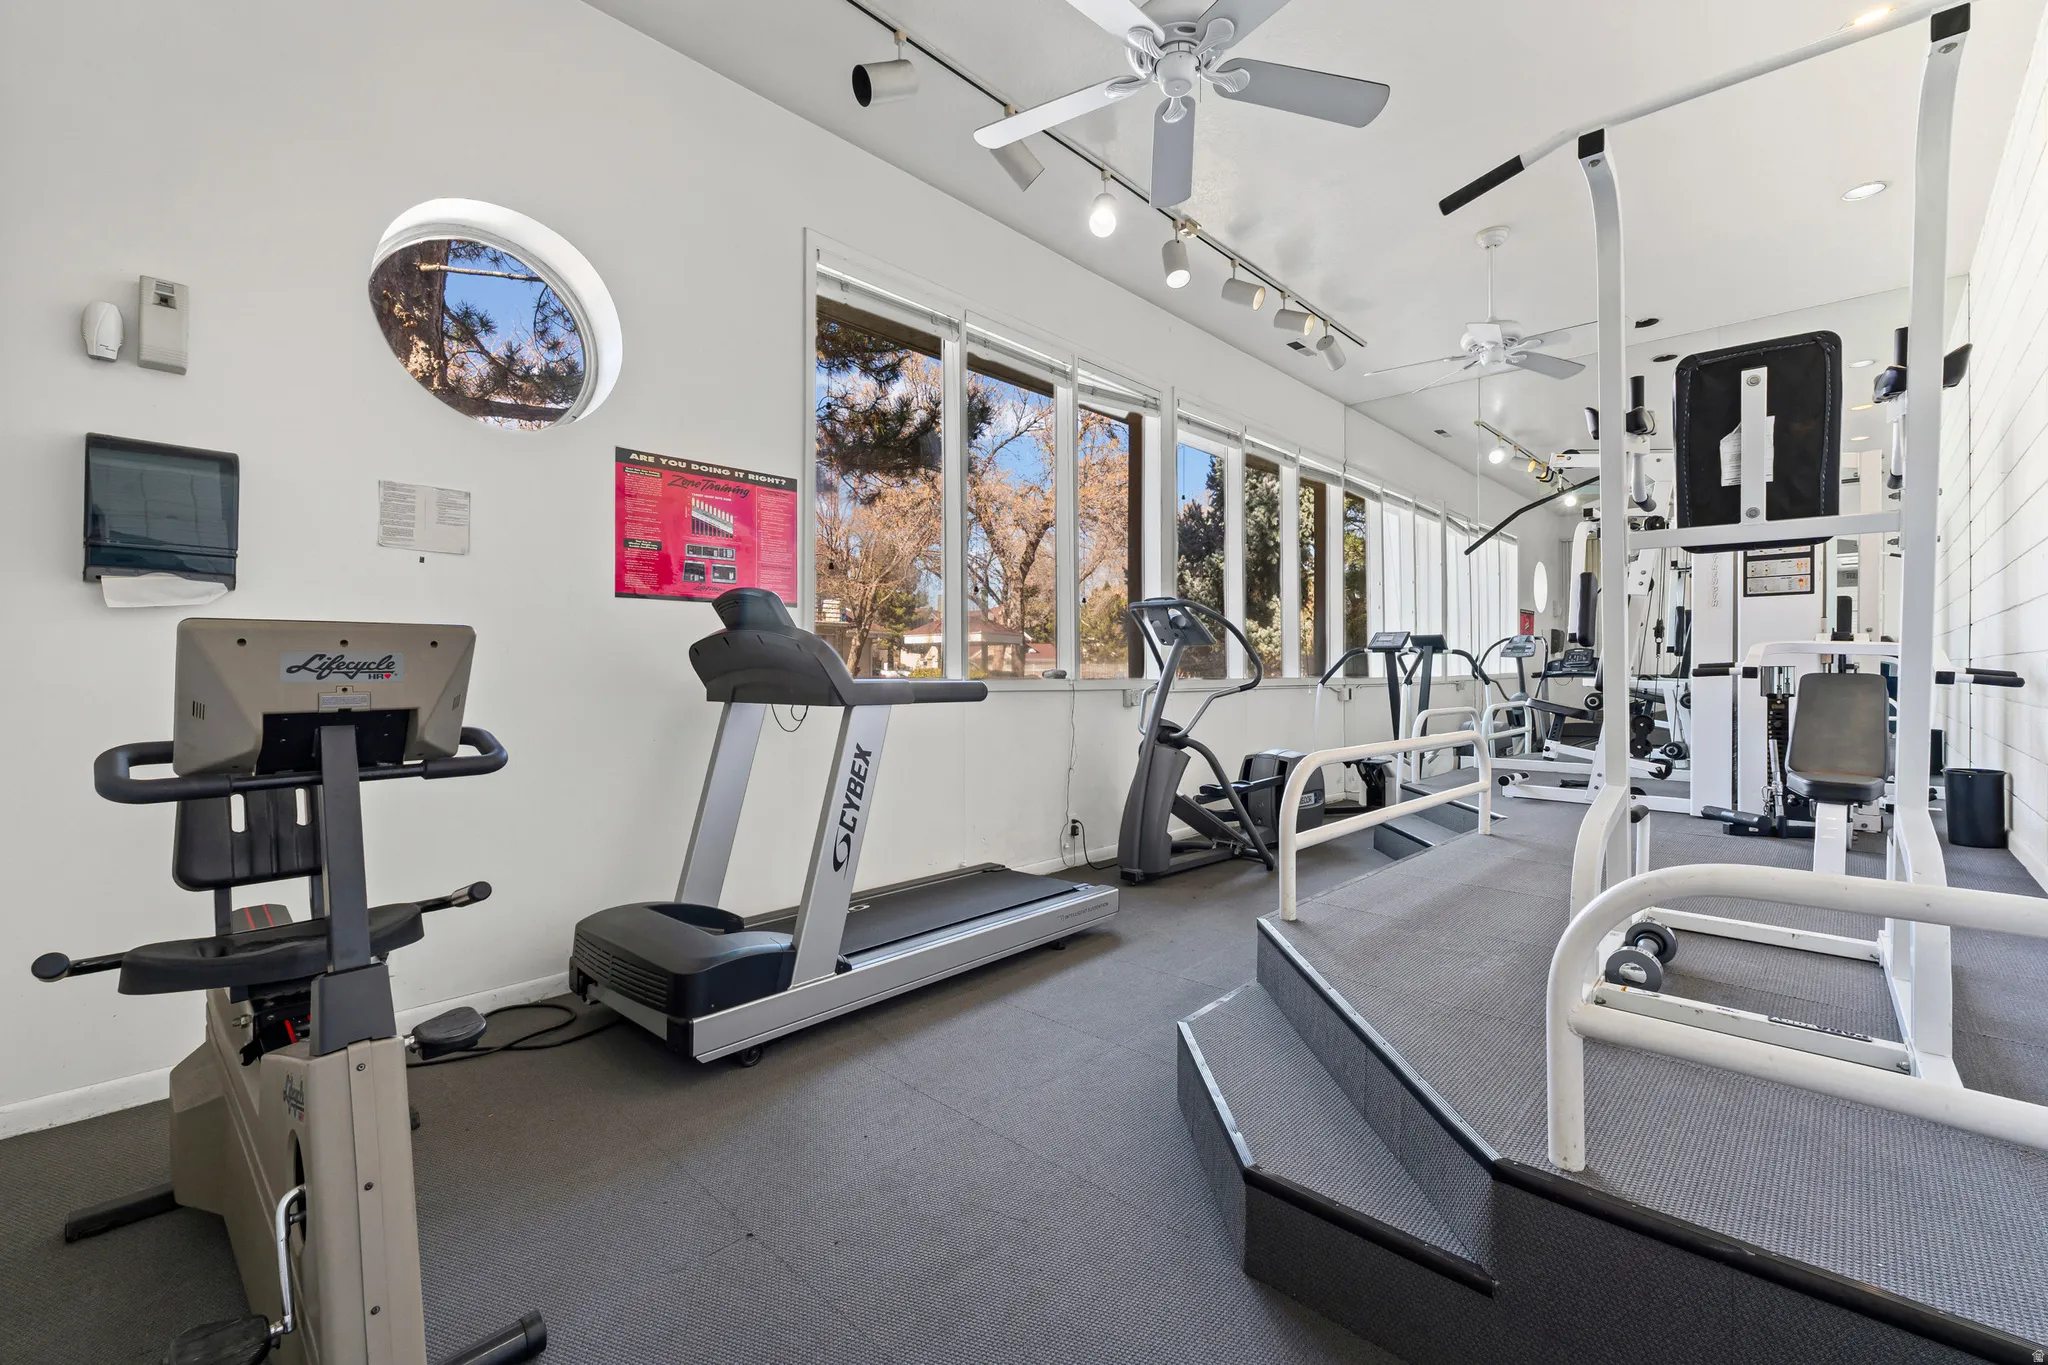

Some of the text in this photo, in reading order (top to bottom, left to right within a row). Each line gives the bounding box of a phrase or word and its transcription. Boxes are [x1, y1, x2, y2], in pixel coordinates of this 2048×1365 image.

[629, 453, 787, 486] ARE YOU DOING IT RIGHT?
[667, 474, 701, 489] Zone
[700, 479, 750, 499] Training
[286, 653, 396, 680] Lifecycle
[838, 742, 873, 834] CYBEX
